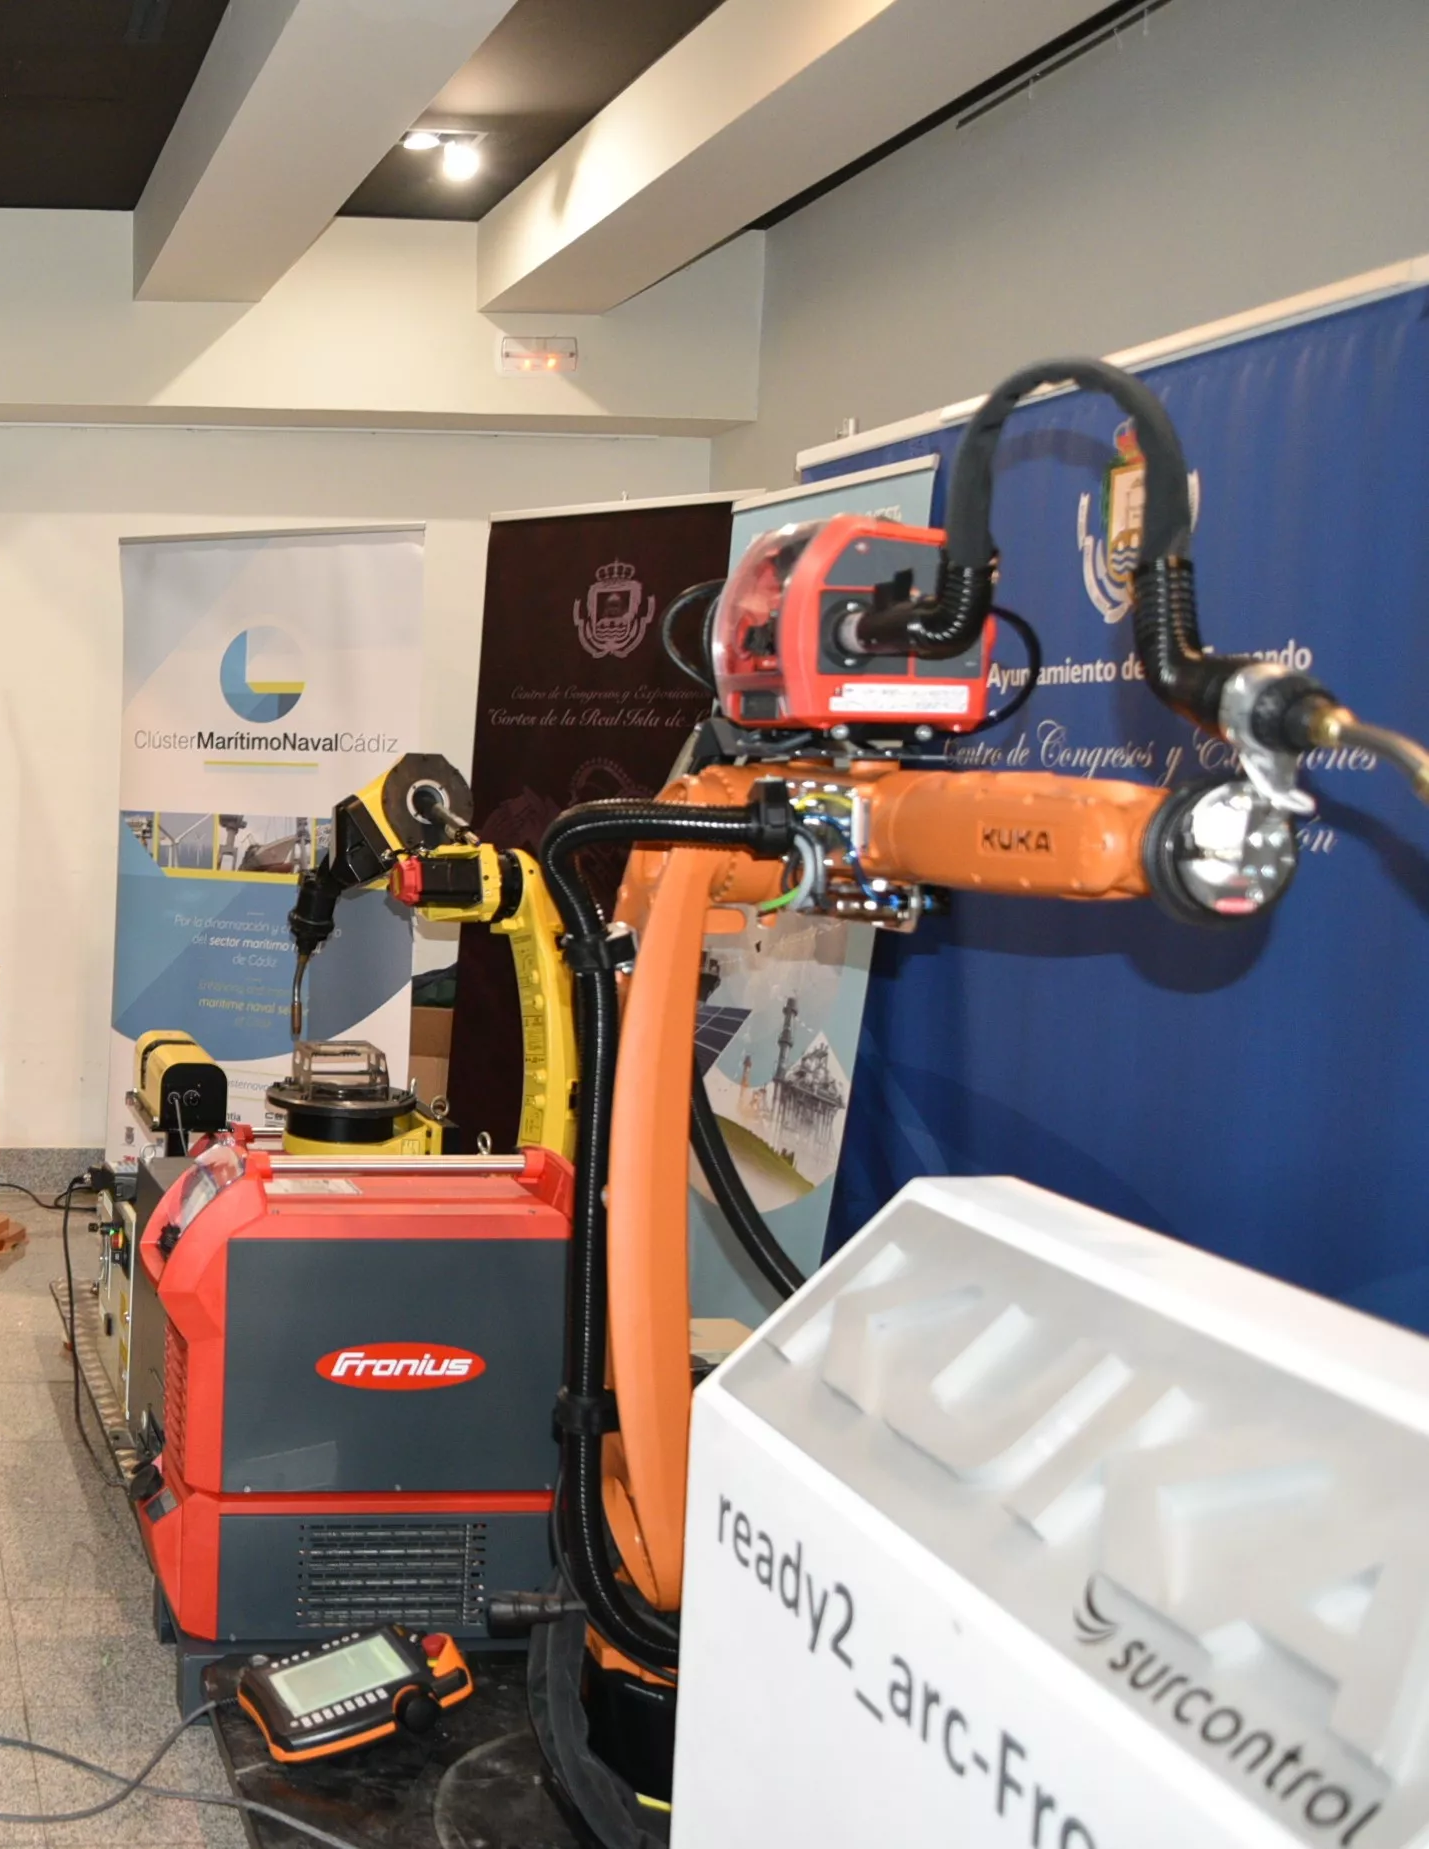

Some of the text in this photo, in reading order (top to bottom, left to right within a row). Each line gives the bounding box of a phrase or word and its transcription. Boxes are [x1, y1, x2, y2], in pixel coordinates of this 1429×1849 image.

[986, 656, 1116, 695] Ayunamiento
[548, 685, 560, 699] de
[539, 708, 557, 726] de
[560, 708, 576, 725] la
[579, 708, 624, 727] Real
[622, 708, 660, 727] Isla
[665, 708, 682, 727] de
[1006, 733, 1030, 767] de
[1036, 719, 1153, 779] Congresos
[1155, 745, 1183, 788] y
[981, 827, 1050, 852] KUKA
[209, 936, 241, 948] sector
[242, 938, 289, 952] marítimo
[331, 1352, 473, 1376] Fronius
[1108, 1638, 1381, 1847] surcontrol
